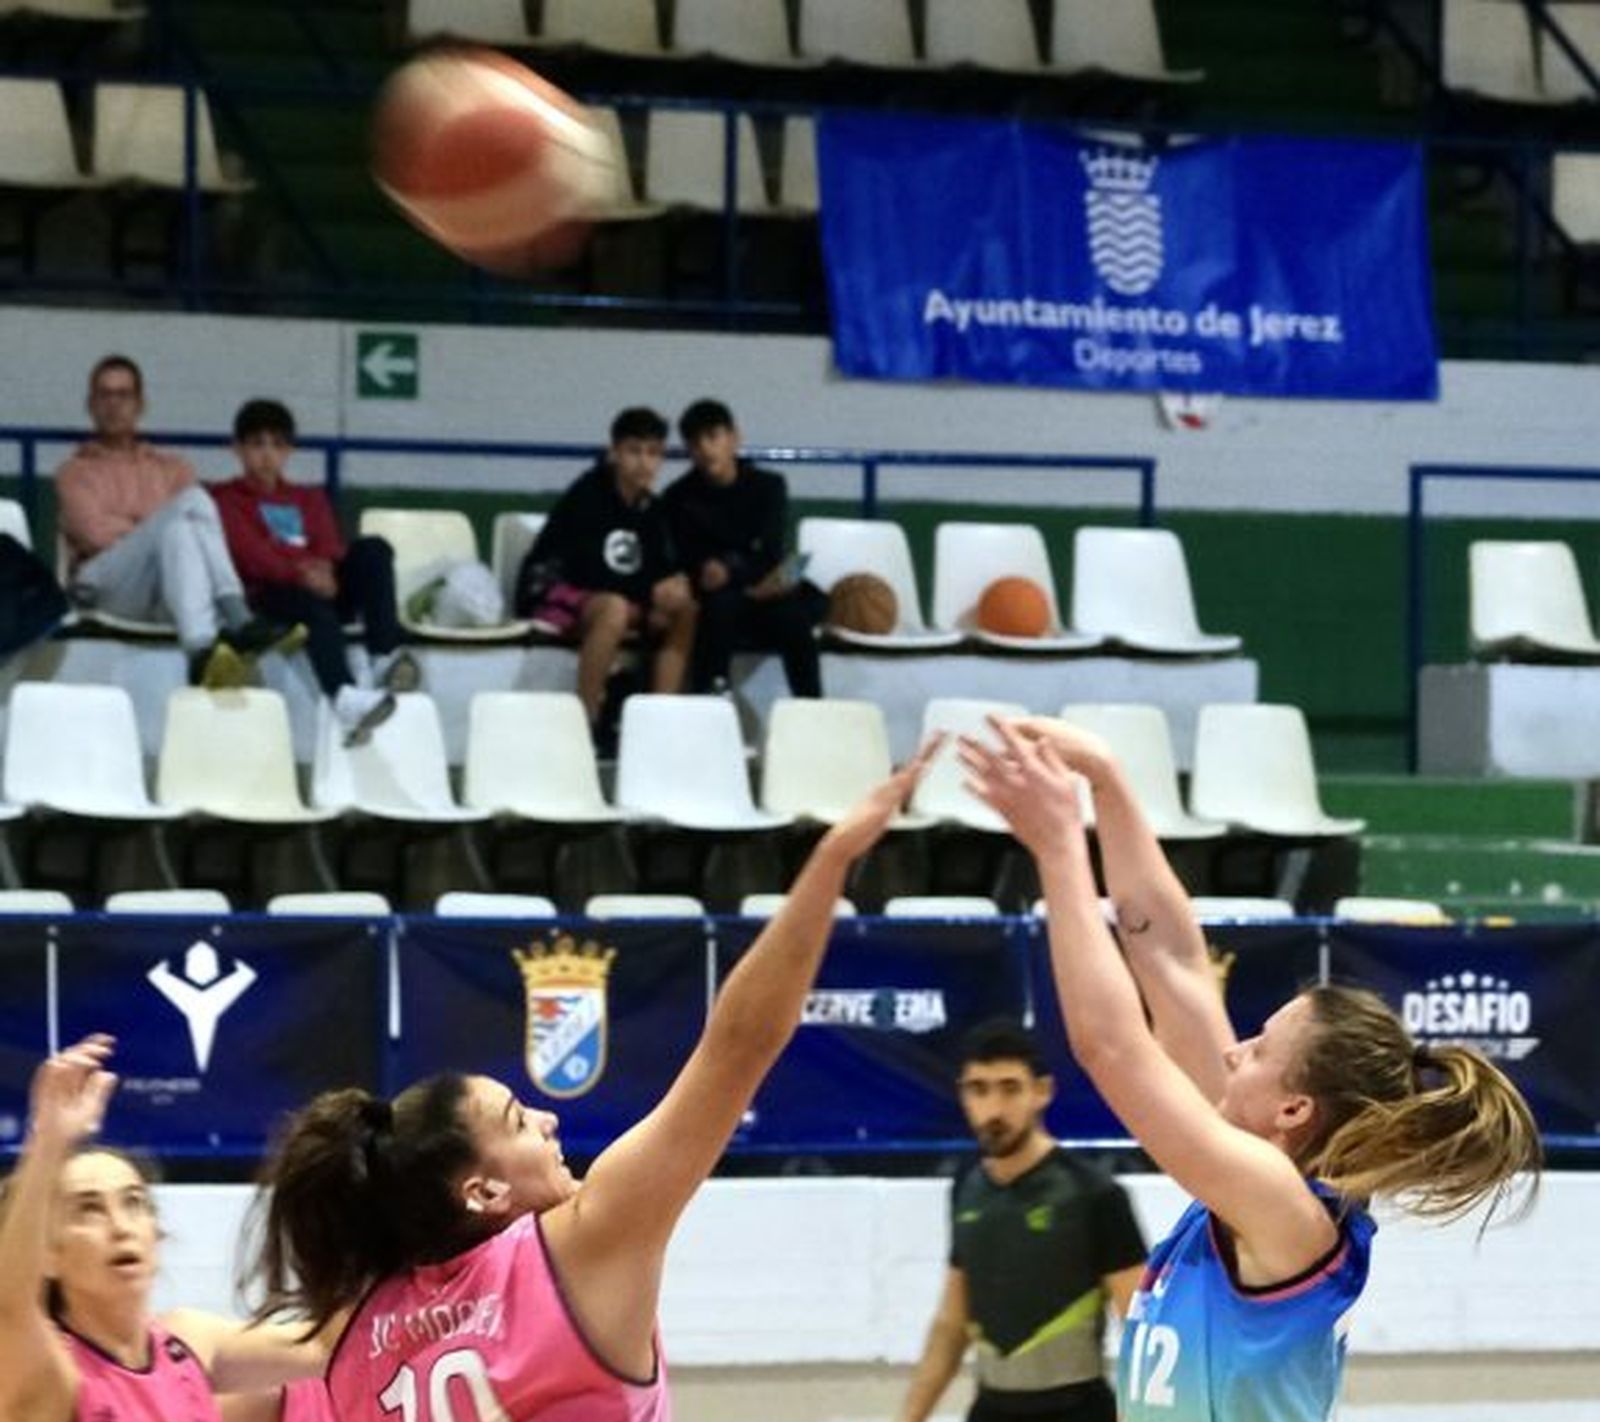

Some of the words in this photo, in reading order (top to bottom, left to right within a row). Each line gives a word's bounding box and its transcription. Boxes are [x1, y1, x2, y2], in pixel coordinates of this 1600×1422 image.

[923, 290, 1188, 336] Ayuntamiento
[1195, 303, 1241, 338] de
[1250, 304, 1342, 346] Jerez
[1073, 338, 1202, 375] Deportes
[1128, 1321, 1181, 1407] 12
